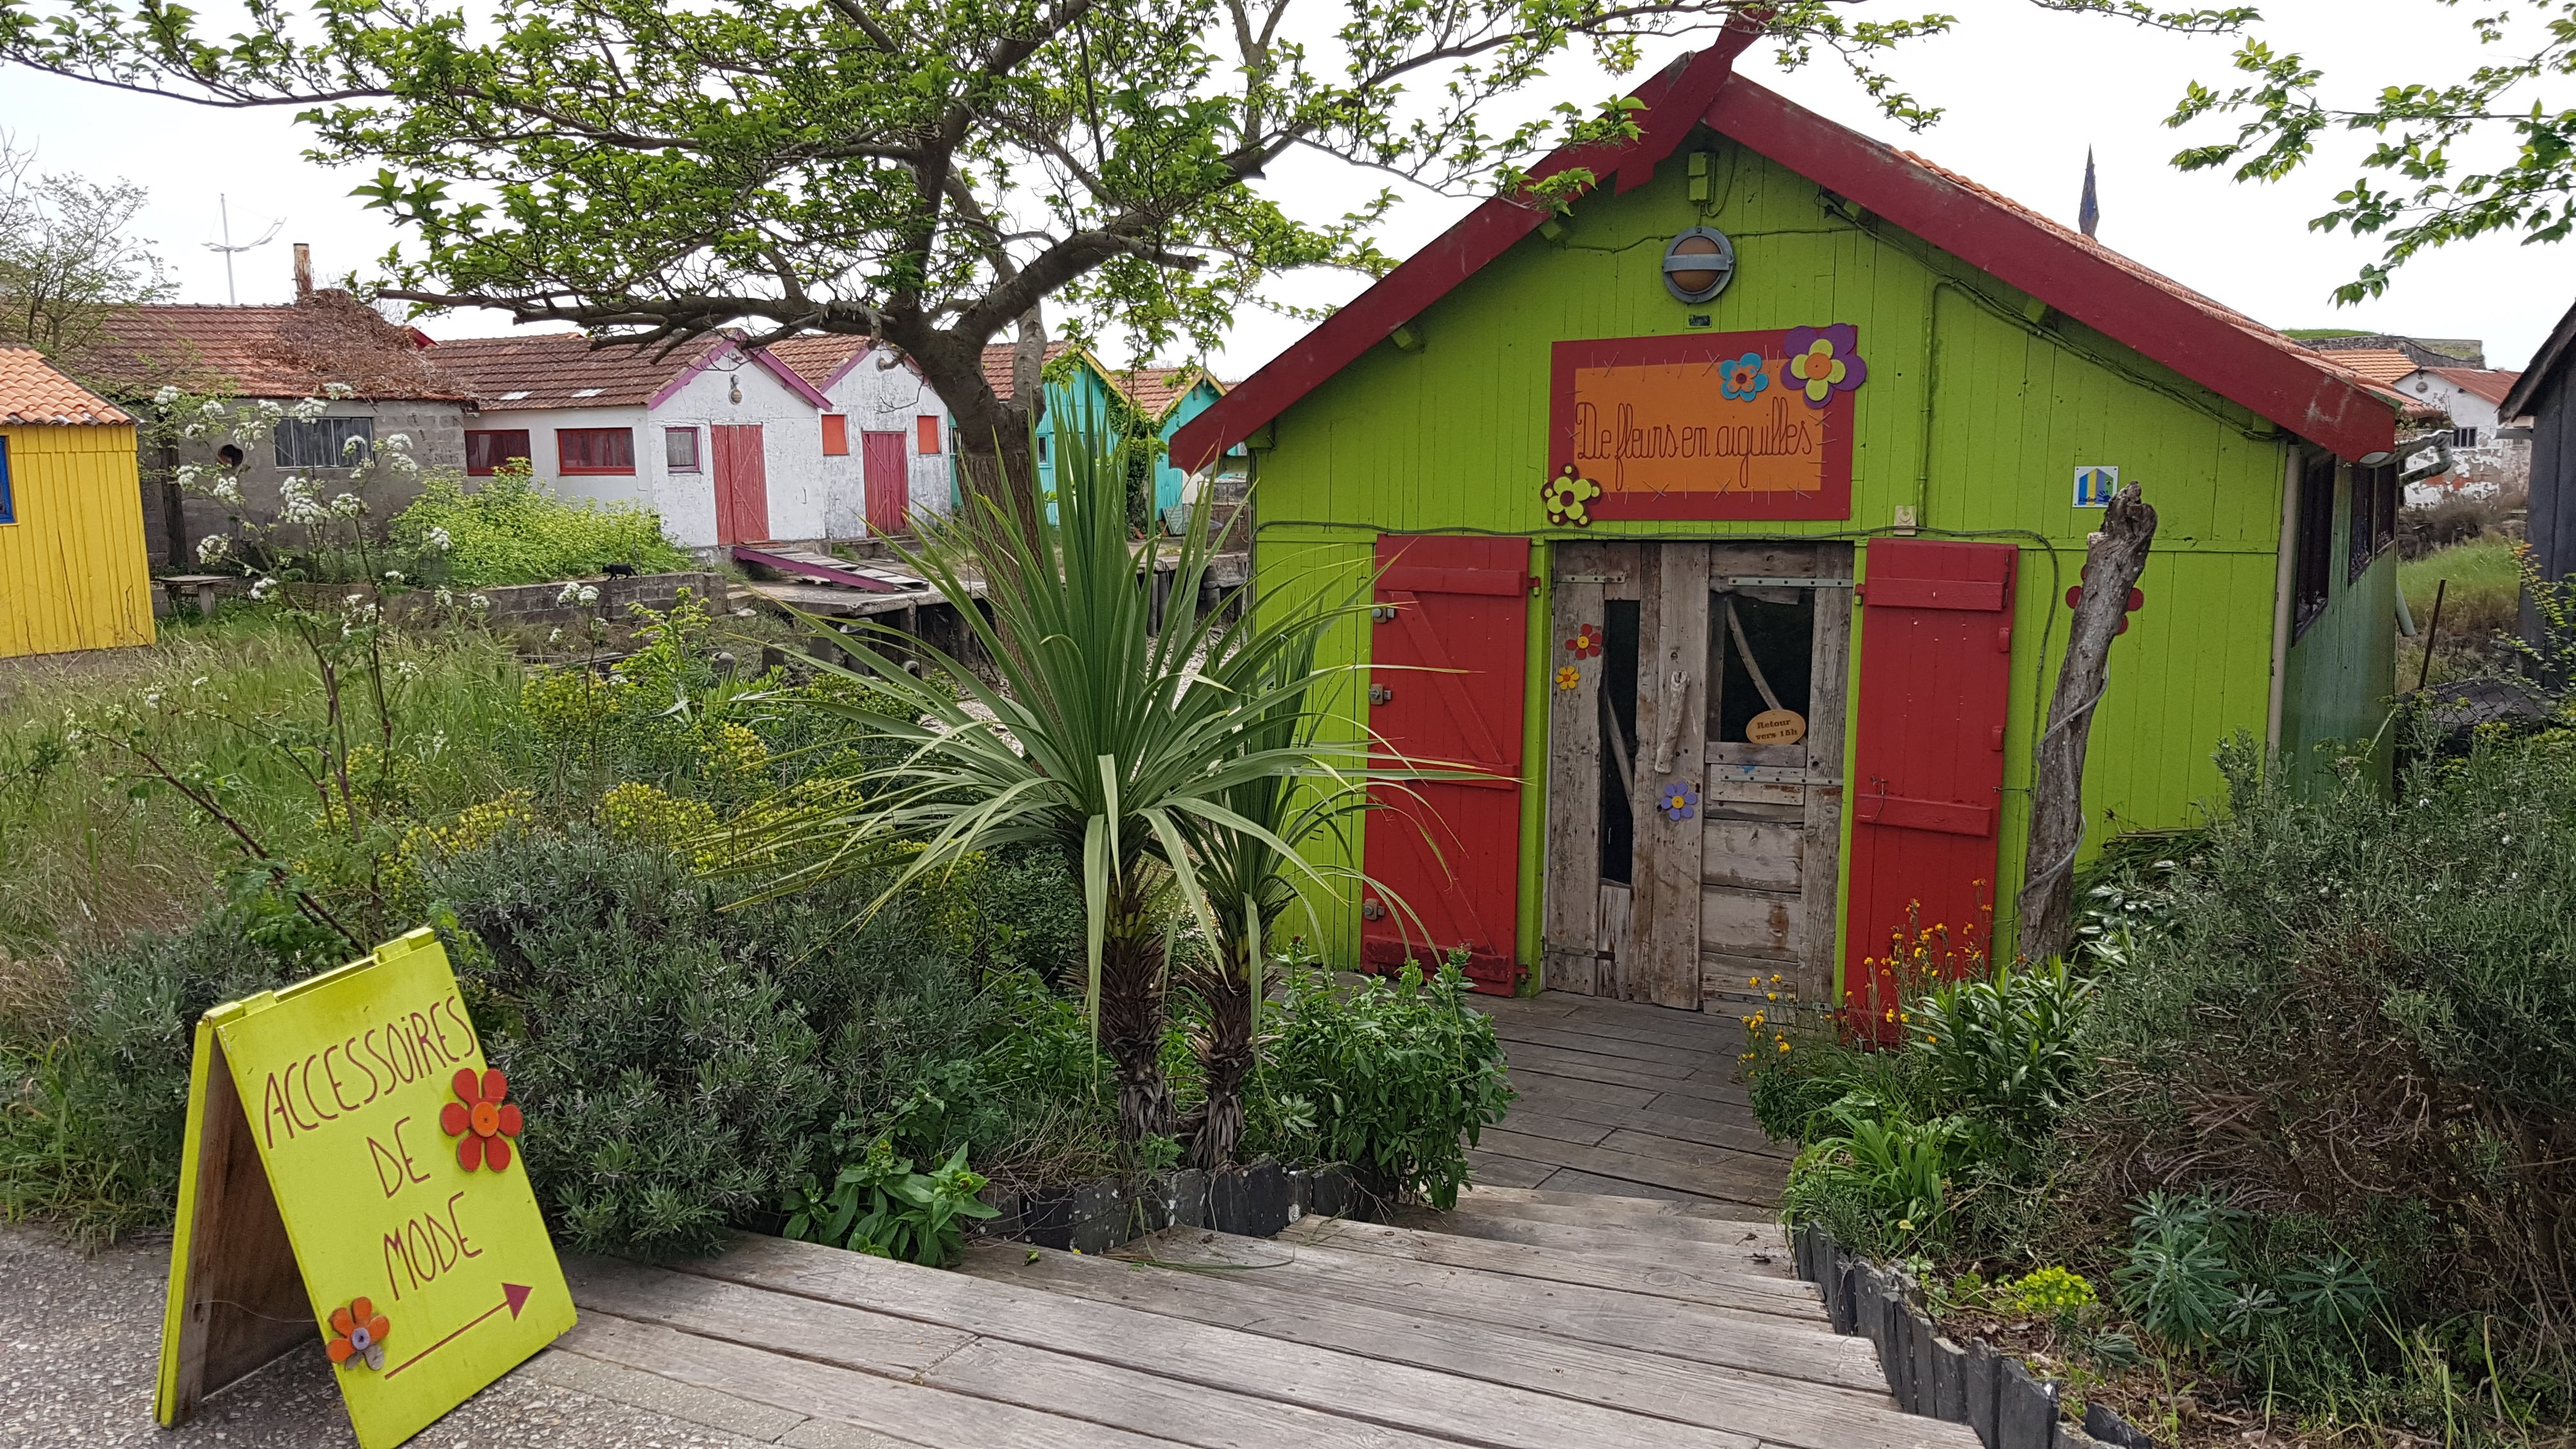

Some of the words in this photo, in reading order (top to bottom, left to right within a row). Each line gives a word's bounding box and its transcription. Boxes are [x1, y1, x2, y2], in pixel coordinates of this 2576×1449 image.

[1575, 402, 1611, 460] De
[1616, 402, 1678, 491] fleurs
[1682, 426, 1711, 458] en
[1715, 396, 1813, 489] aiguilles
[1756, 719, 1791, 729] Retour
[1780, 728, 1798, 737] 15h
[366, 1116, 431, 1199] DE
[383, 1191, 484, 1301] MODE
